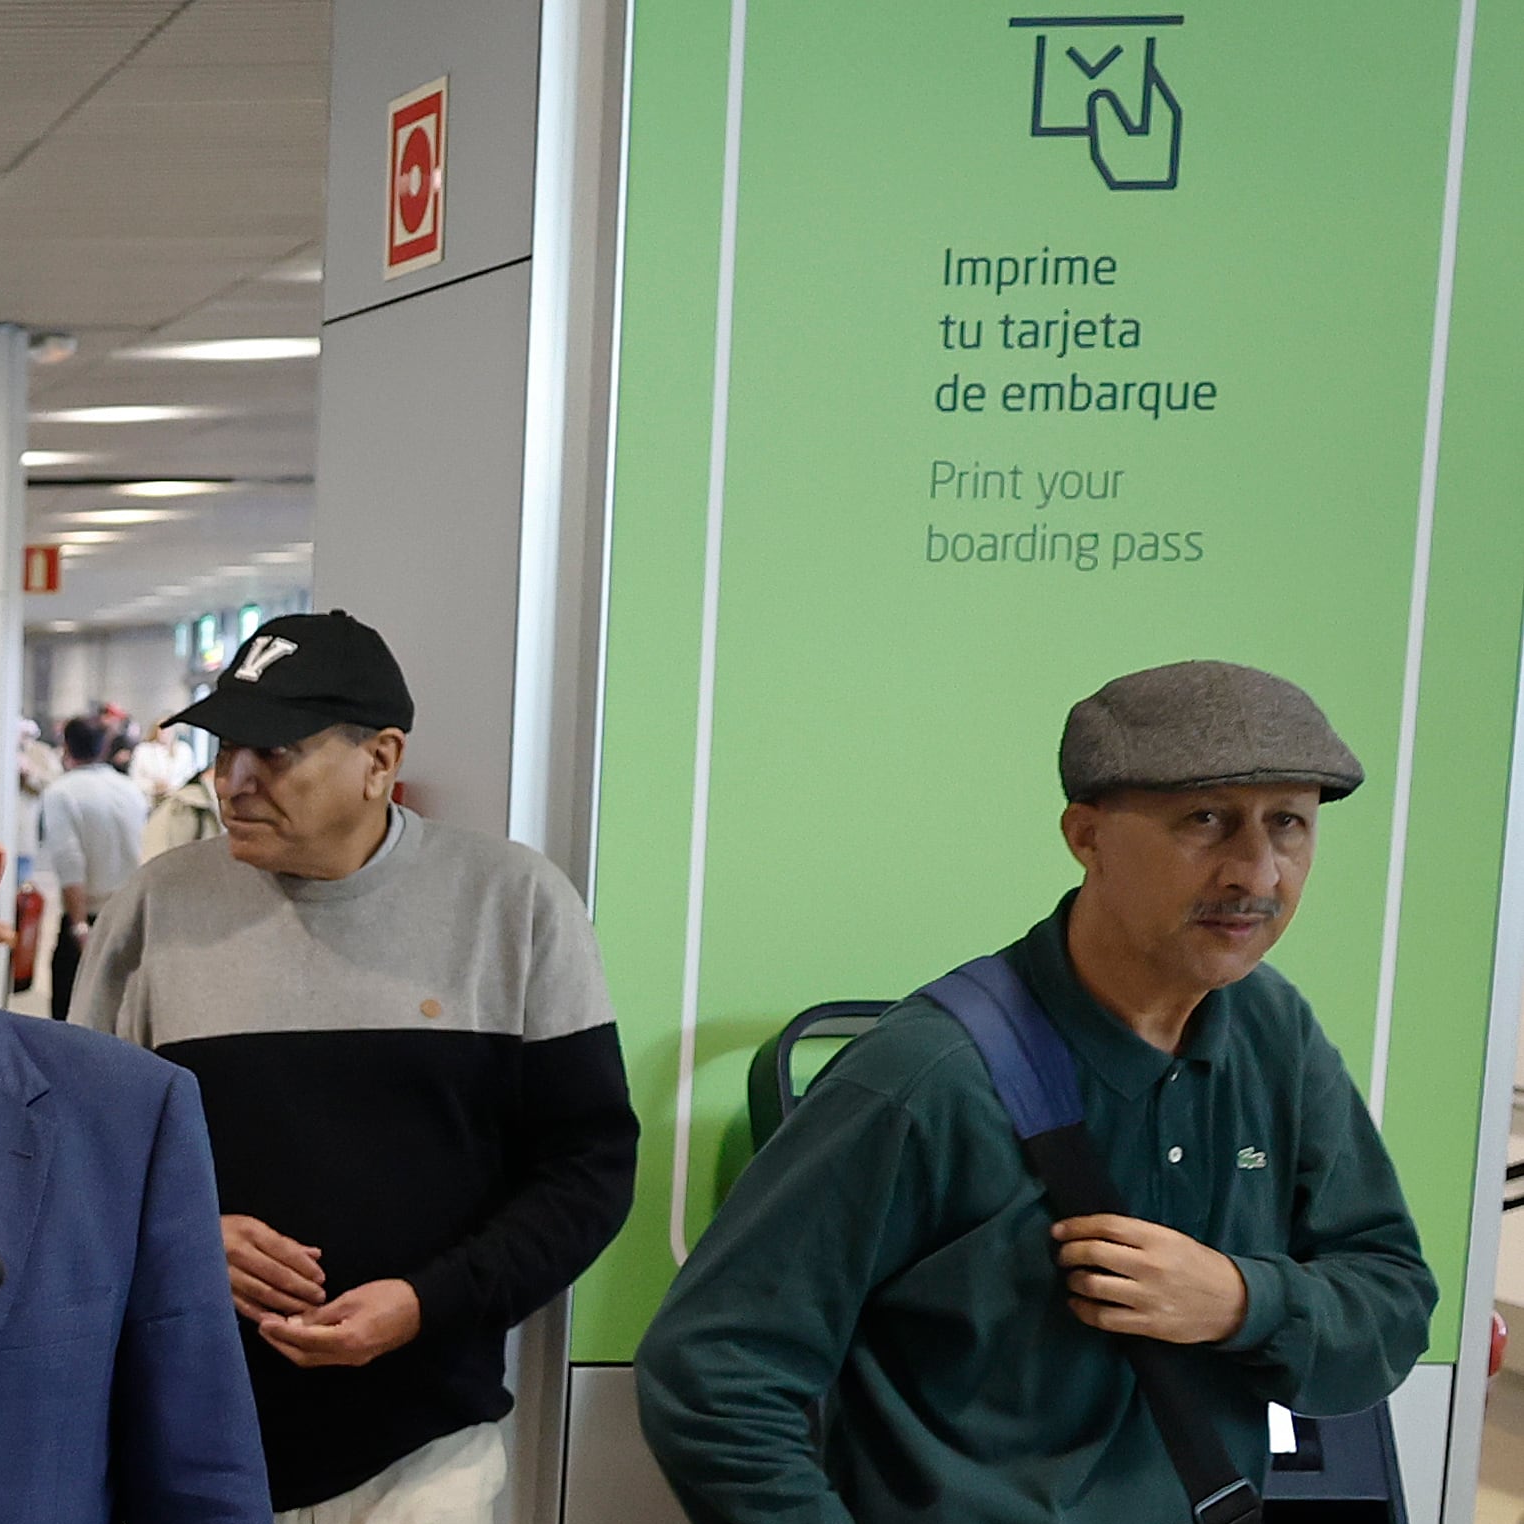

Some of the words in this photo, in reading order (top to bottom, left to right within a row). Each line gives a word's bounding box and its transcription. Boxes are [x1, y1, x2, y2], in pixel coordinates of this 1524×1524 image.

[942, 246, 1118, 297] Imprime
[937, 313, 984, 351] tu
[997, 307, 1142, 359] tarjeta
[933, 371, 987, 413] de
[1001, 371, 1218, 422] embarque
[929, 459, 1024, 501] Print
[1035, 468, 1126, 510] your
[926, 522, 1100, 572] boarding
[1111, 531, 1205, 571] pass
